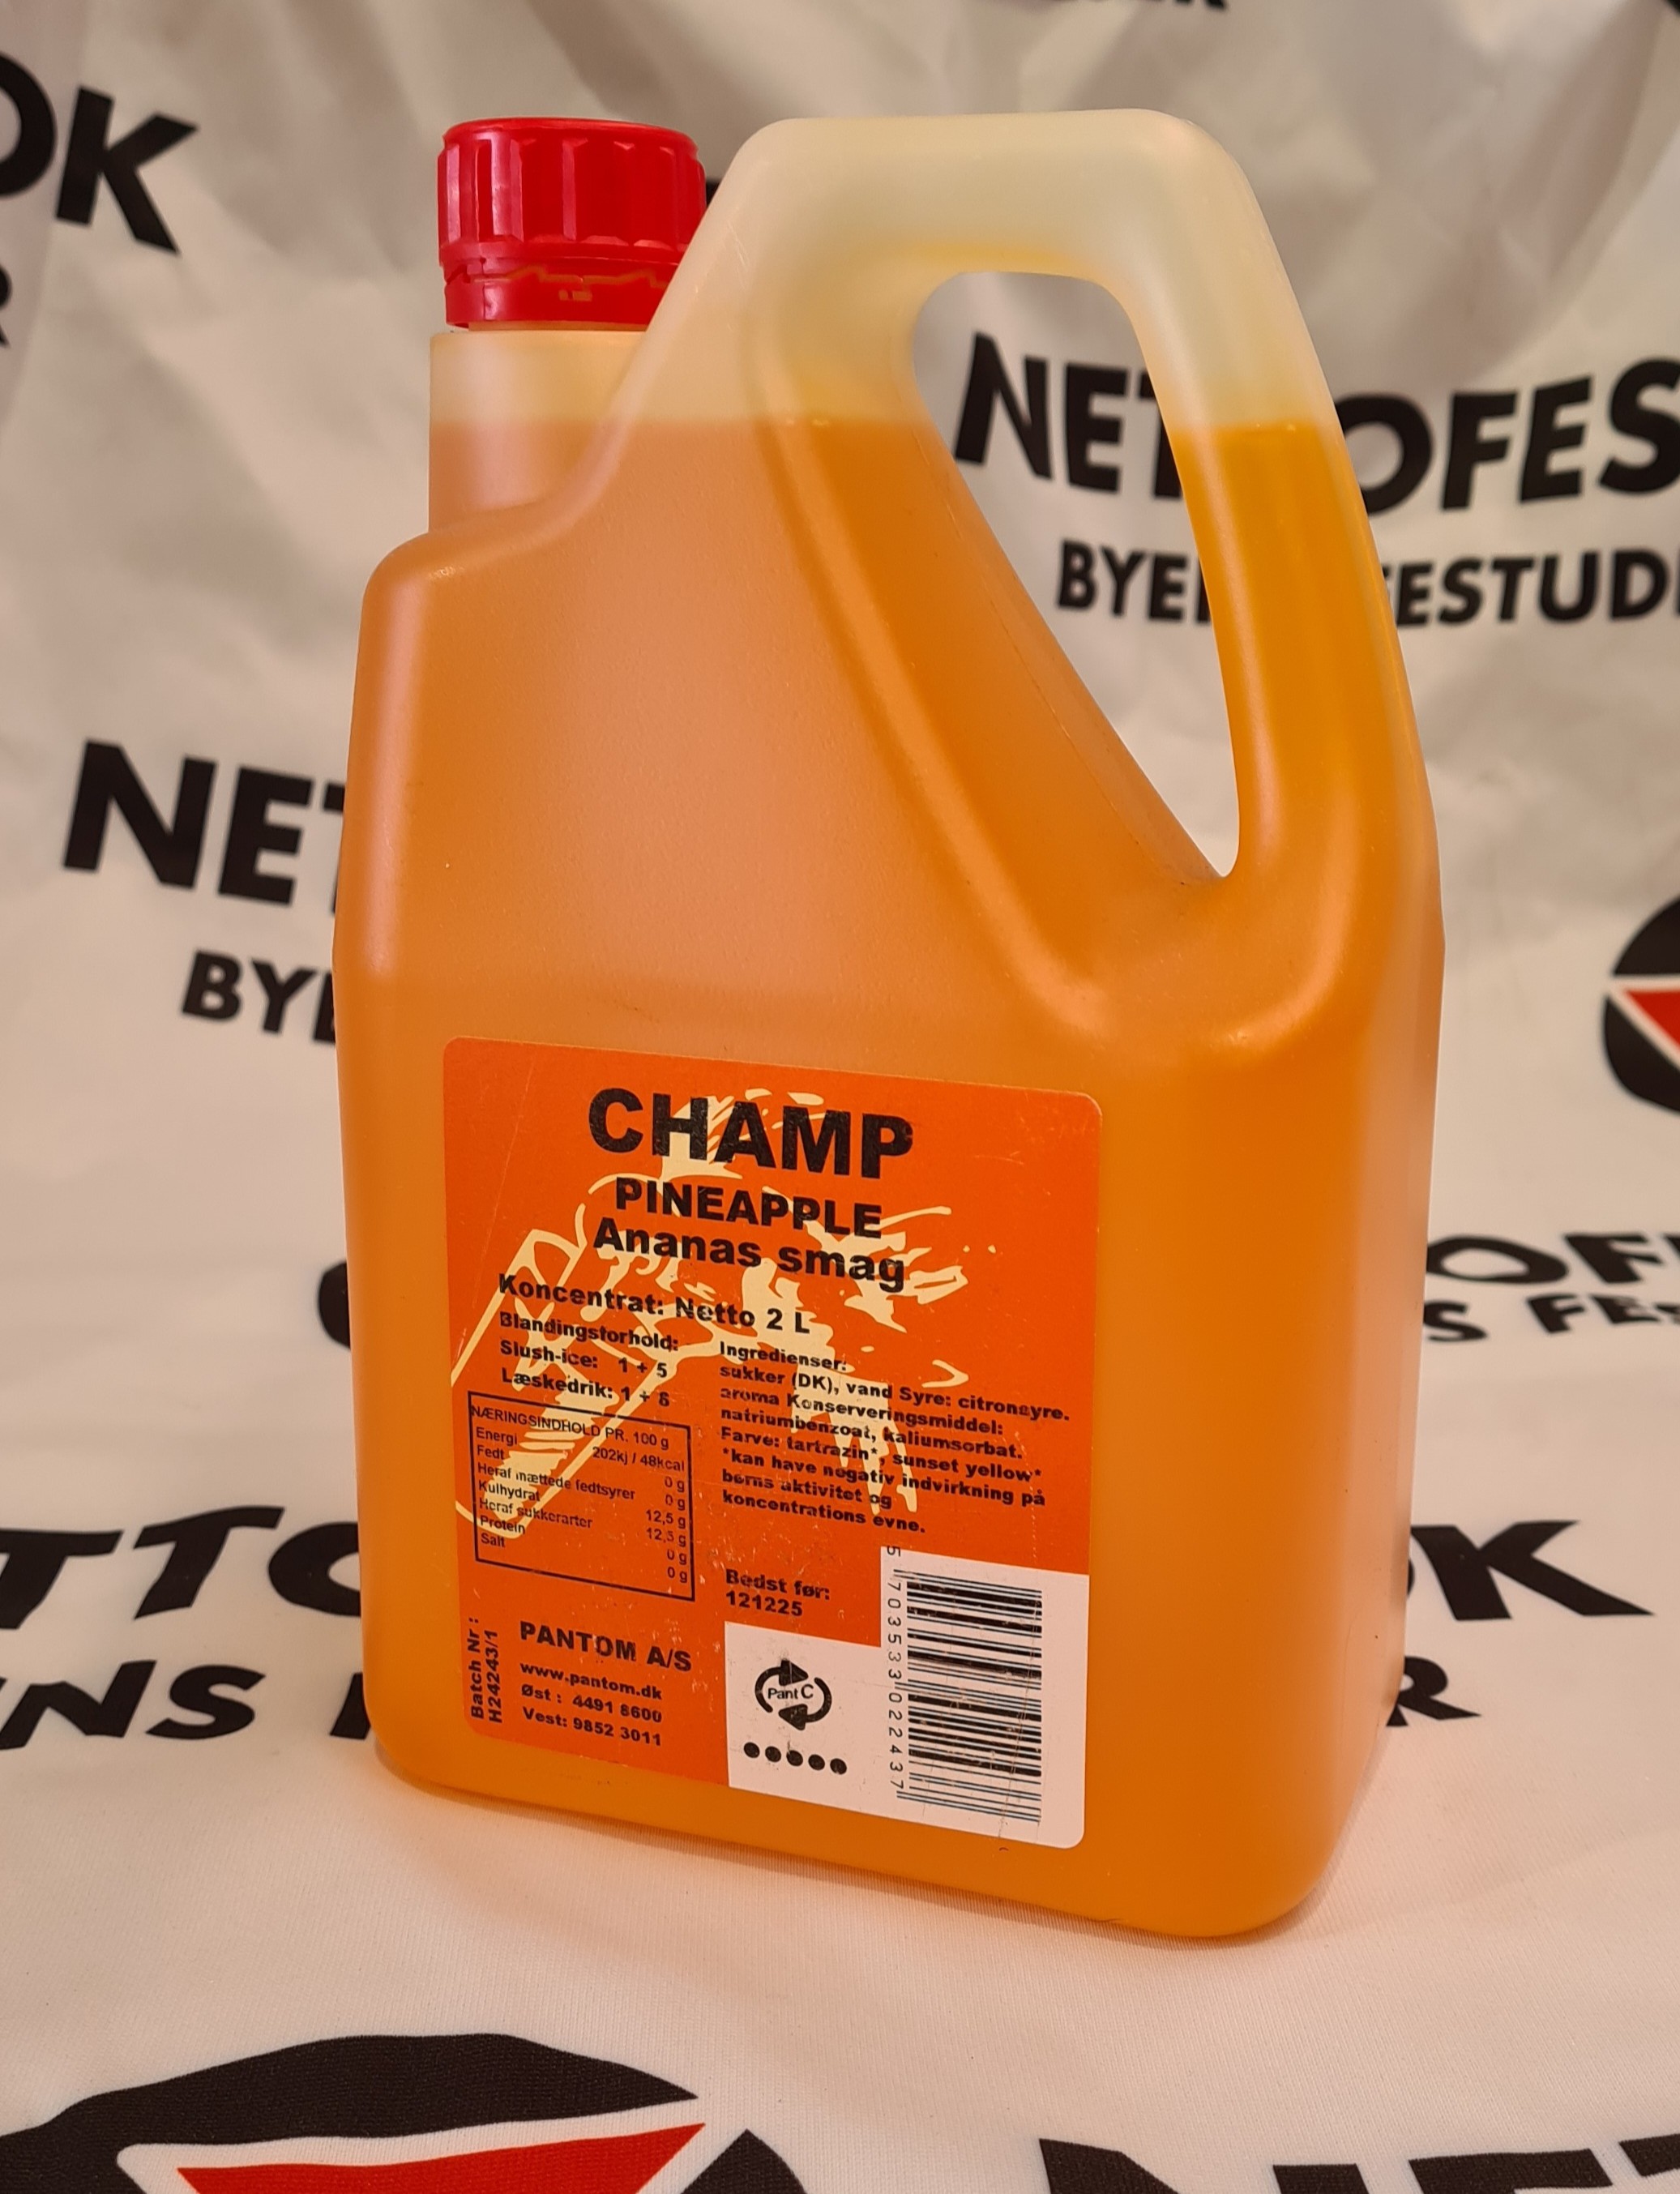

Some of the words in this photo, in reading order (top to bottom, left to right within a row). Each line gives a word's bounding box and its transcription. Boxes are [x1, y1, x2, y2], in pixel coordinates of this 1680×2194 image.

[588, 1087, 914, 1179] CHAMP
[615, 1177, 882, 1239] PINEAPPLE
[593, 1217, 762, 1268] Ananas
[777, 1244, 905, 1294] smag
[499, 1273, 665, 1316] Koncentrat:
[676, 1297, 755, 1328] Netto
[766, 1307, 783, 1330] 2
[795, 1311, 810, 1334] L
[499, 1311, 679, 1351] Blandingsforhold:
[499, 1339, 598, 1368] Slush-ice:
[618, 1357, 628, 1373] 1
[637, 1362, 648, 1373] +
[656, 1362, 668, 1378] 5
[720, 1341, 847, 1371] Ingredienser:
[502, 1367, 613, 1399] Læskedrik:
[621, 1386, 631, 1401] 1
[639, 1391, 650, 1402] +
[720, 1366, 786, 1384] sukker
[791, 1372, 840, 1396] (DK),
[846, 1382, 893, 1400] vand
[899, 1386, 951, 1406] Syre:
[958, 1394, 1070, 1422] citronsyre.
[470, 1405, 601, 1437] NÆRINGSINDHOLD
[605, 1426, 629, 1442] PR.
[633, 1431, 657, 1446] 100
[660, 1437, 669, 1451] g
[720, 1387, 780, 1406] aroma
[787, 1392, 1003, 1435] Konserveringsmiddel:
[720, 1407, 877, 1442] natriumbenzoat,
[883, 1425, 1023, 1459] kaliumsorbat.
[476, 1426, 518, 1447] Energi
[592, 1446, 628, 1465] 202kj
[640, 1454, 685, 1473] 48kcal
[477, 1444, 505, 1461] Fedt
[665, 1476, 673, 1488] 0
[677, 1479, 685, 1492] g
[720, 1426, 780, 1448] Farve:
[892, 1452, 960, 1473] sunset
[477, 1461, 512, 1479] Heraf
[515, 1471, 571, 1490] mættede
[575, 1479, 635, 1499] fedtsyrer
[665, 1494, 673, 1506] 0
[678, 1498, 686, 1511] g
[478, 1479, 541, 1502] Kulhydrat
[646, 1509, 673, 1525] 12,5
[678, 1516, 686, 1529] g
[772, 1455, 817, 1473] have
[823, 1465, 895, 1486] negativ
[902, 1473, 1015, 1505] indvirkning
[1021, 1488, 1046, 1508] på
[780, 1478, 863, 1503] aktivitet
[869, 1492, 892, 1509] og
[479, 1497, 514, 1515] Heraf
[517, 1506, 593, 1529] sukkerarter
[678, 1534, 686, 1547] g
[722, 1489, 866, 1525] koncentrations
[872, 1514, 926, 1533] evne.
[480, 1514, 526, 1534] Protein
[678, 1552, 687, 1565] g
[481, 1532, 506, 1548] Salt
[667, 1566, 675, 1578] 0
[679, 1571, 688, 1584] g
[725, 1568, 788, 1593] Bedst
[794, 1580, 830, 1601] før:
[725, 1589, 803, 1617] 121225
[467, 1628, 481, 1653] Nr
[519, 1620, 637, 1662] PANTOM
[646, 1645, 692, 1672] A/S
[887, 1581, 902, 1680] 703533
[468, 1660, 485, 1719] Batch
[484, 1630, 502, 1723] H24243/1
[519, 1662, 663, 1700] www.pantom.dk
[767, 1687, 799, 1700] Pant
[800, 1683, 814, 1700] C
[520, 1683, 552, 1701] Øst
[572, 1694, 613, 1715] 4491
[619, 1703, 663, 1724] 8600
[523, 1706, 567, 1728] Vest:
[572, 1717, 614, 1738] 9852
[619, 1726, 662, 1747] 3011
[888, 1691, 904, 1790] 022437
